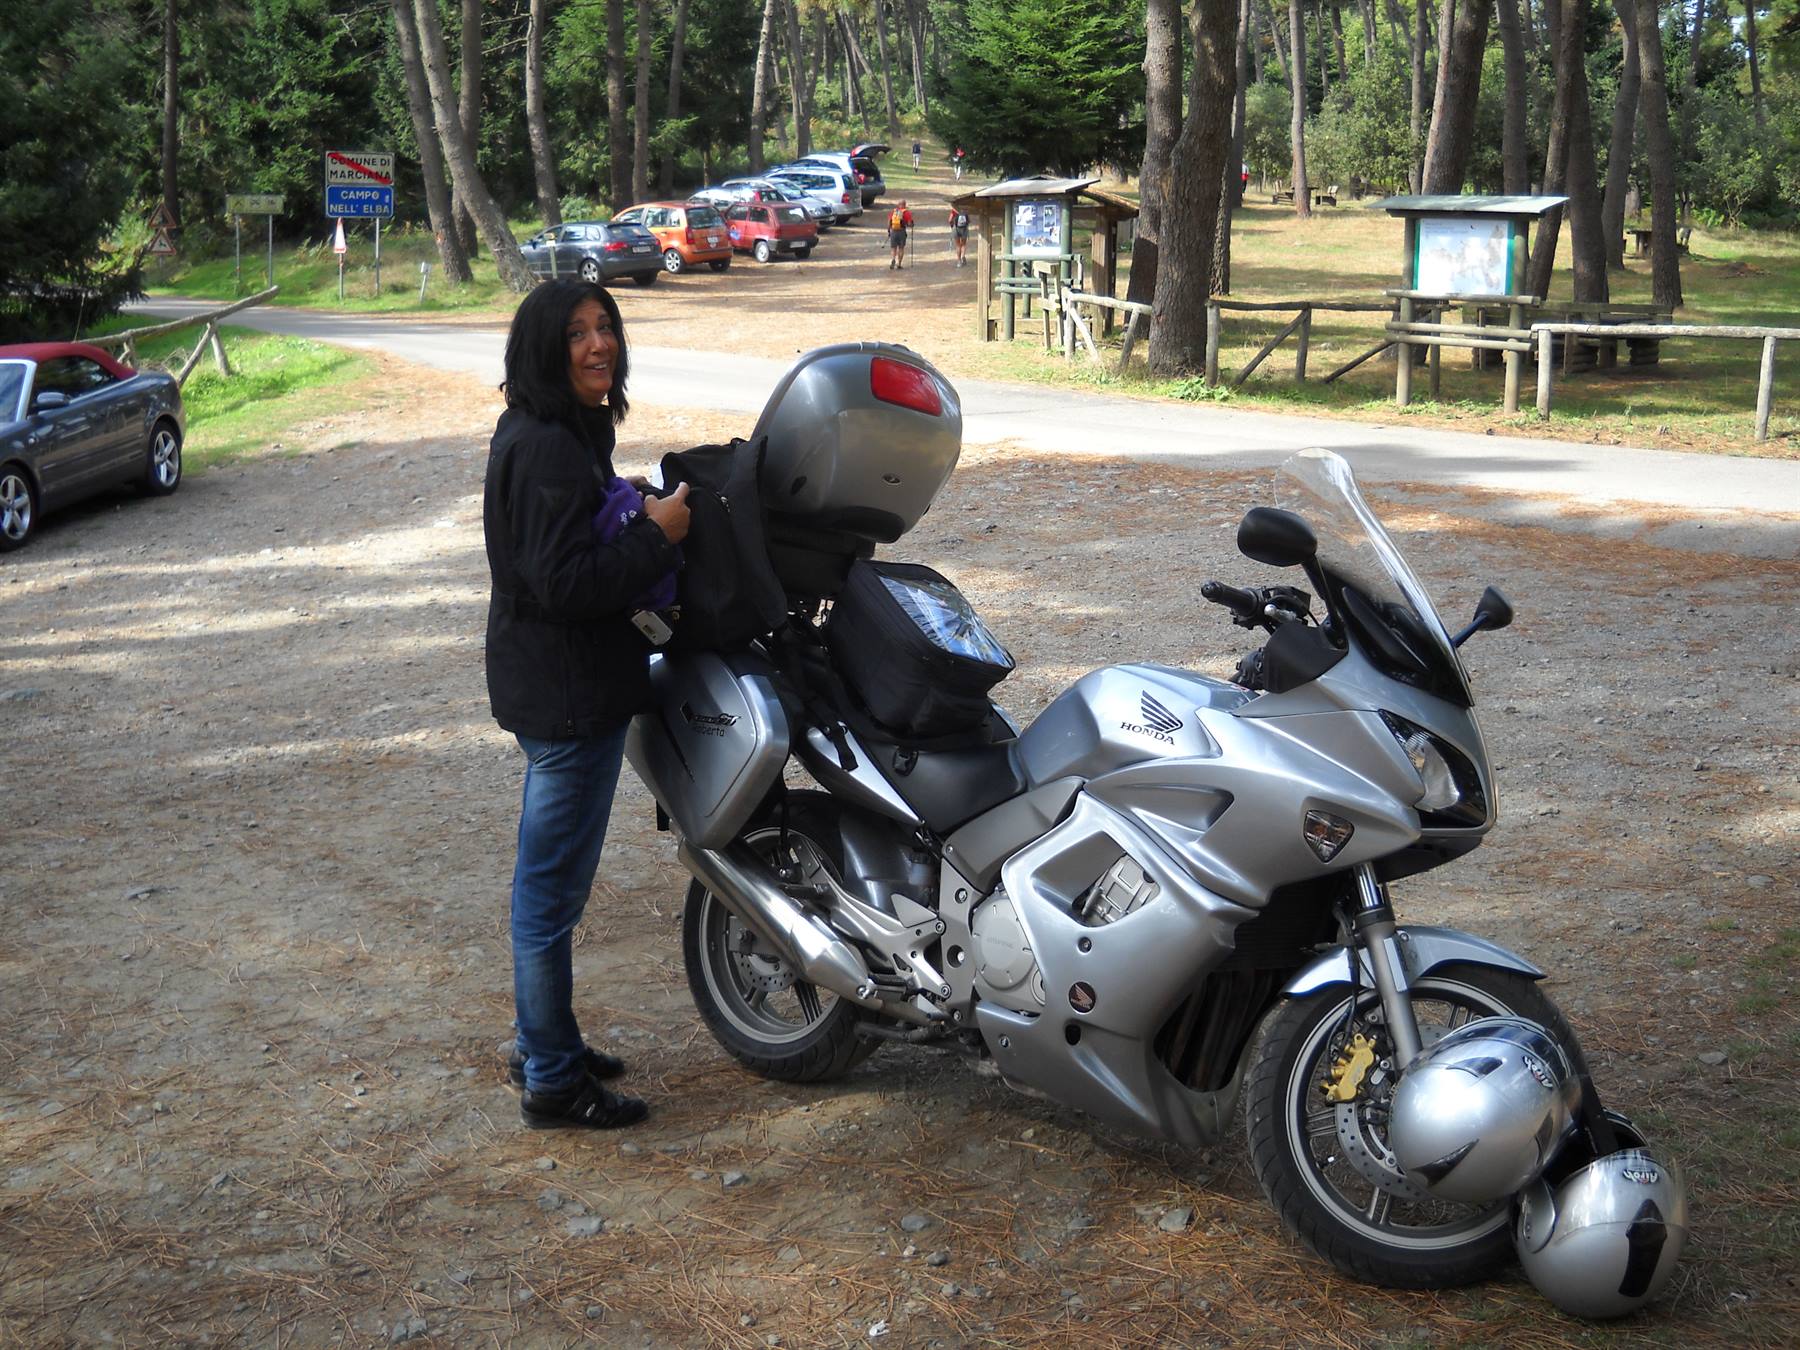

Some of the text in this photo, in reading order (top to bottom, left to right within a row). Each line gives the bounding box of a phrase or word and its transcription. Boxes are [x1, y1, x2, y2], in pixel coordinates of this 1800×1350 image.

[331, 157, 390, 167] COMUNE DI
[329, 170, 391, 180] MARCIANA
[340, 190, 380, 200] CAMPO
[329, 203, 390, 214] NELL' ELBA
[1120, 721, 1175, 746] HONDA
